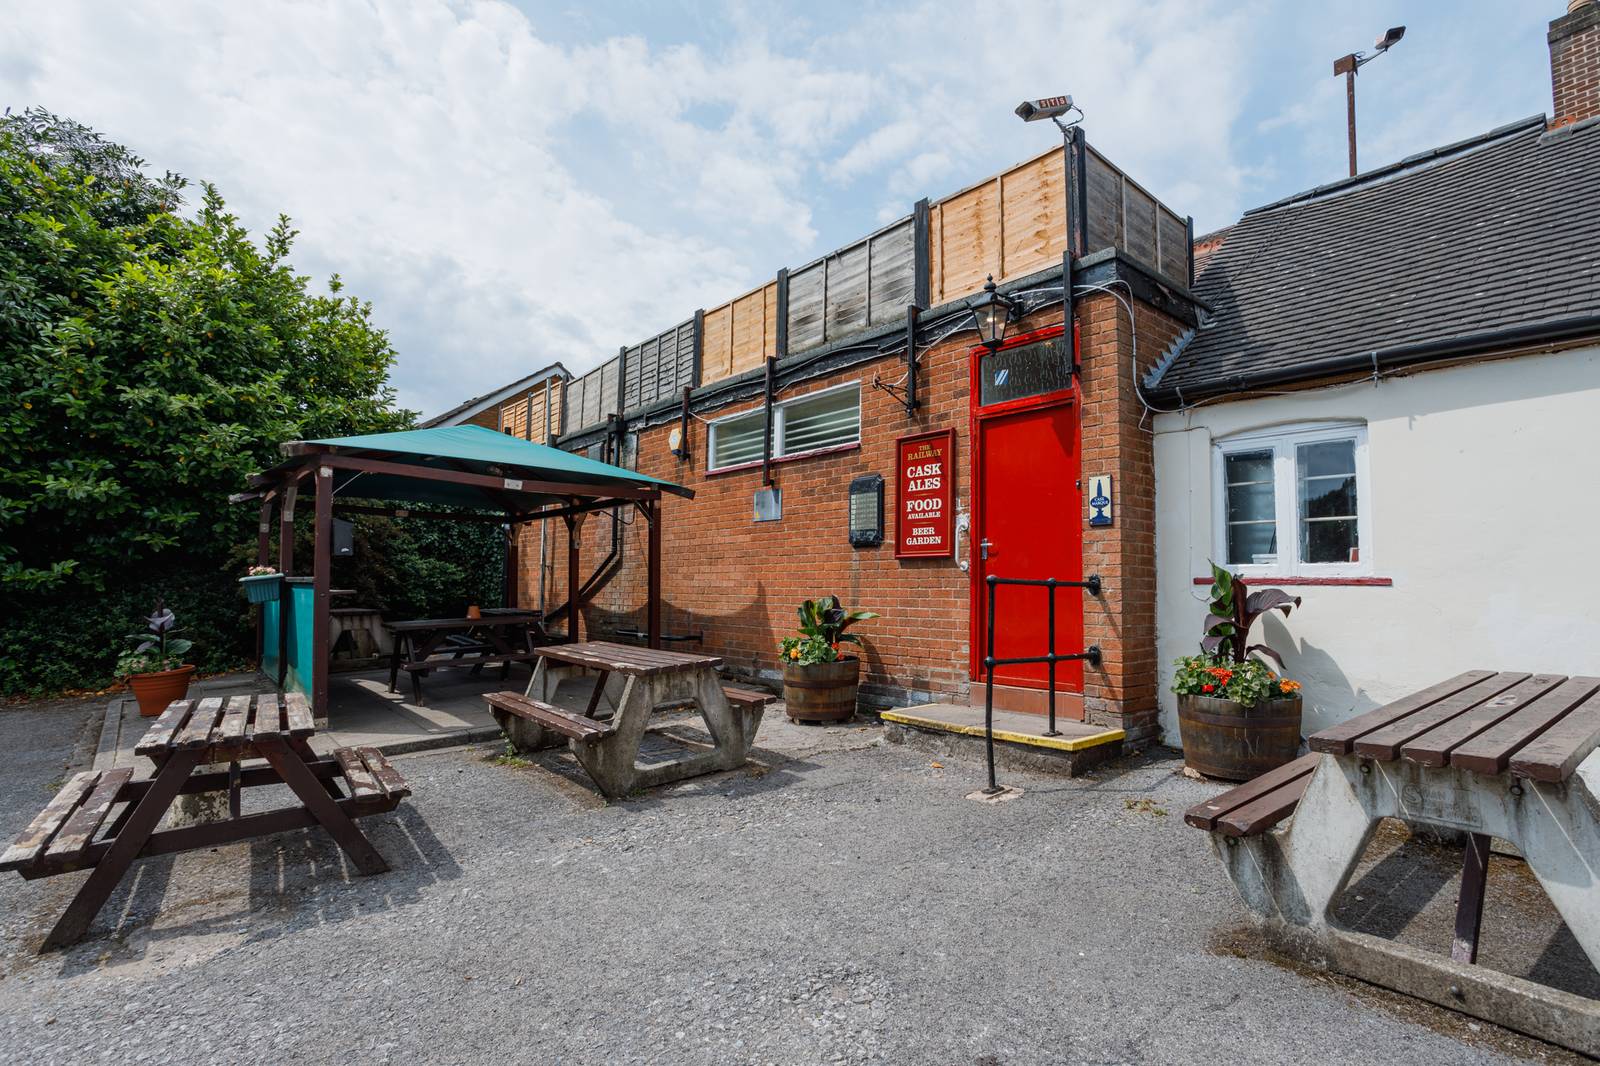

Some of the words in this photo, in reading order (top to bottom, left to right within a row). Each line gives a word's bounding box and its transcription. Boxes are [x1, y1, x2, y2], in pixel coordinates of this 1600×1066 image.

[907, 448, 943, 461] RAILWAY
[907, 463, 942, 478] CASK
[907, 477, 941, 492] ALES
[906, 498, 942, 512] FOOD
[907, 512, 941, 520] AVAILABLE
[912, 527, 935, 536] BEER
[906, 536, 941, 545] GARDEN
